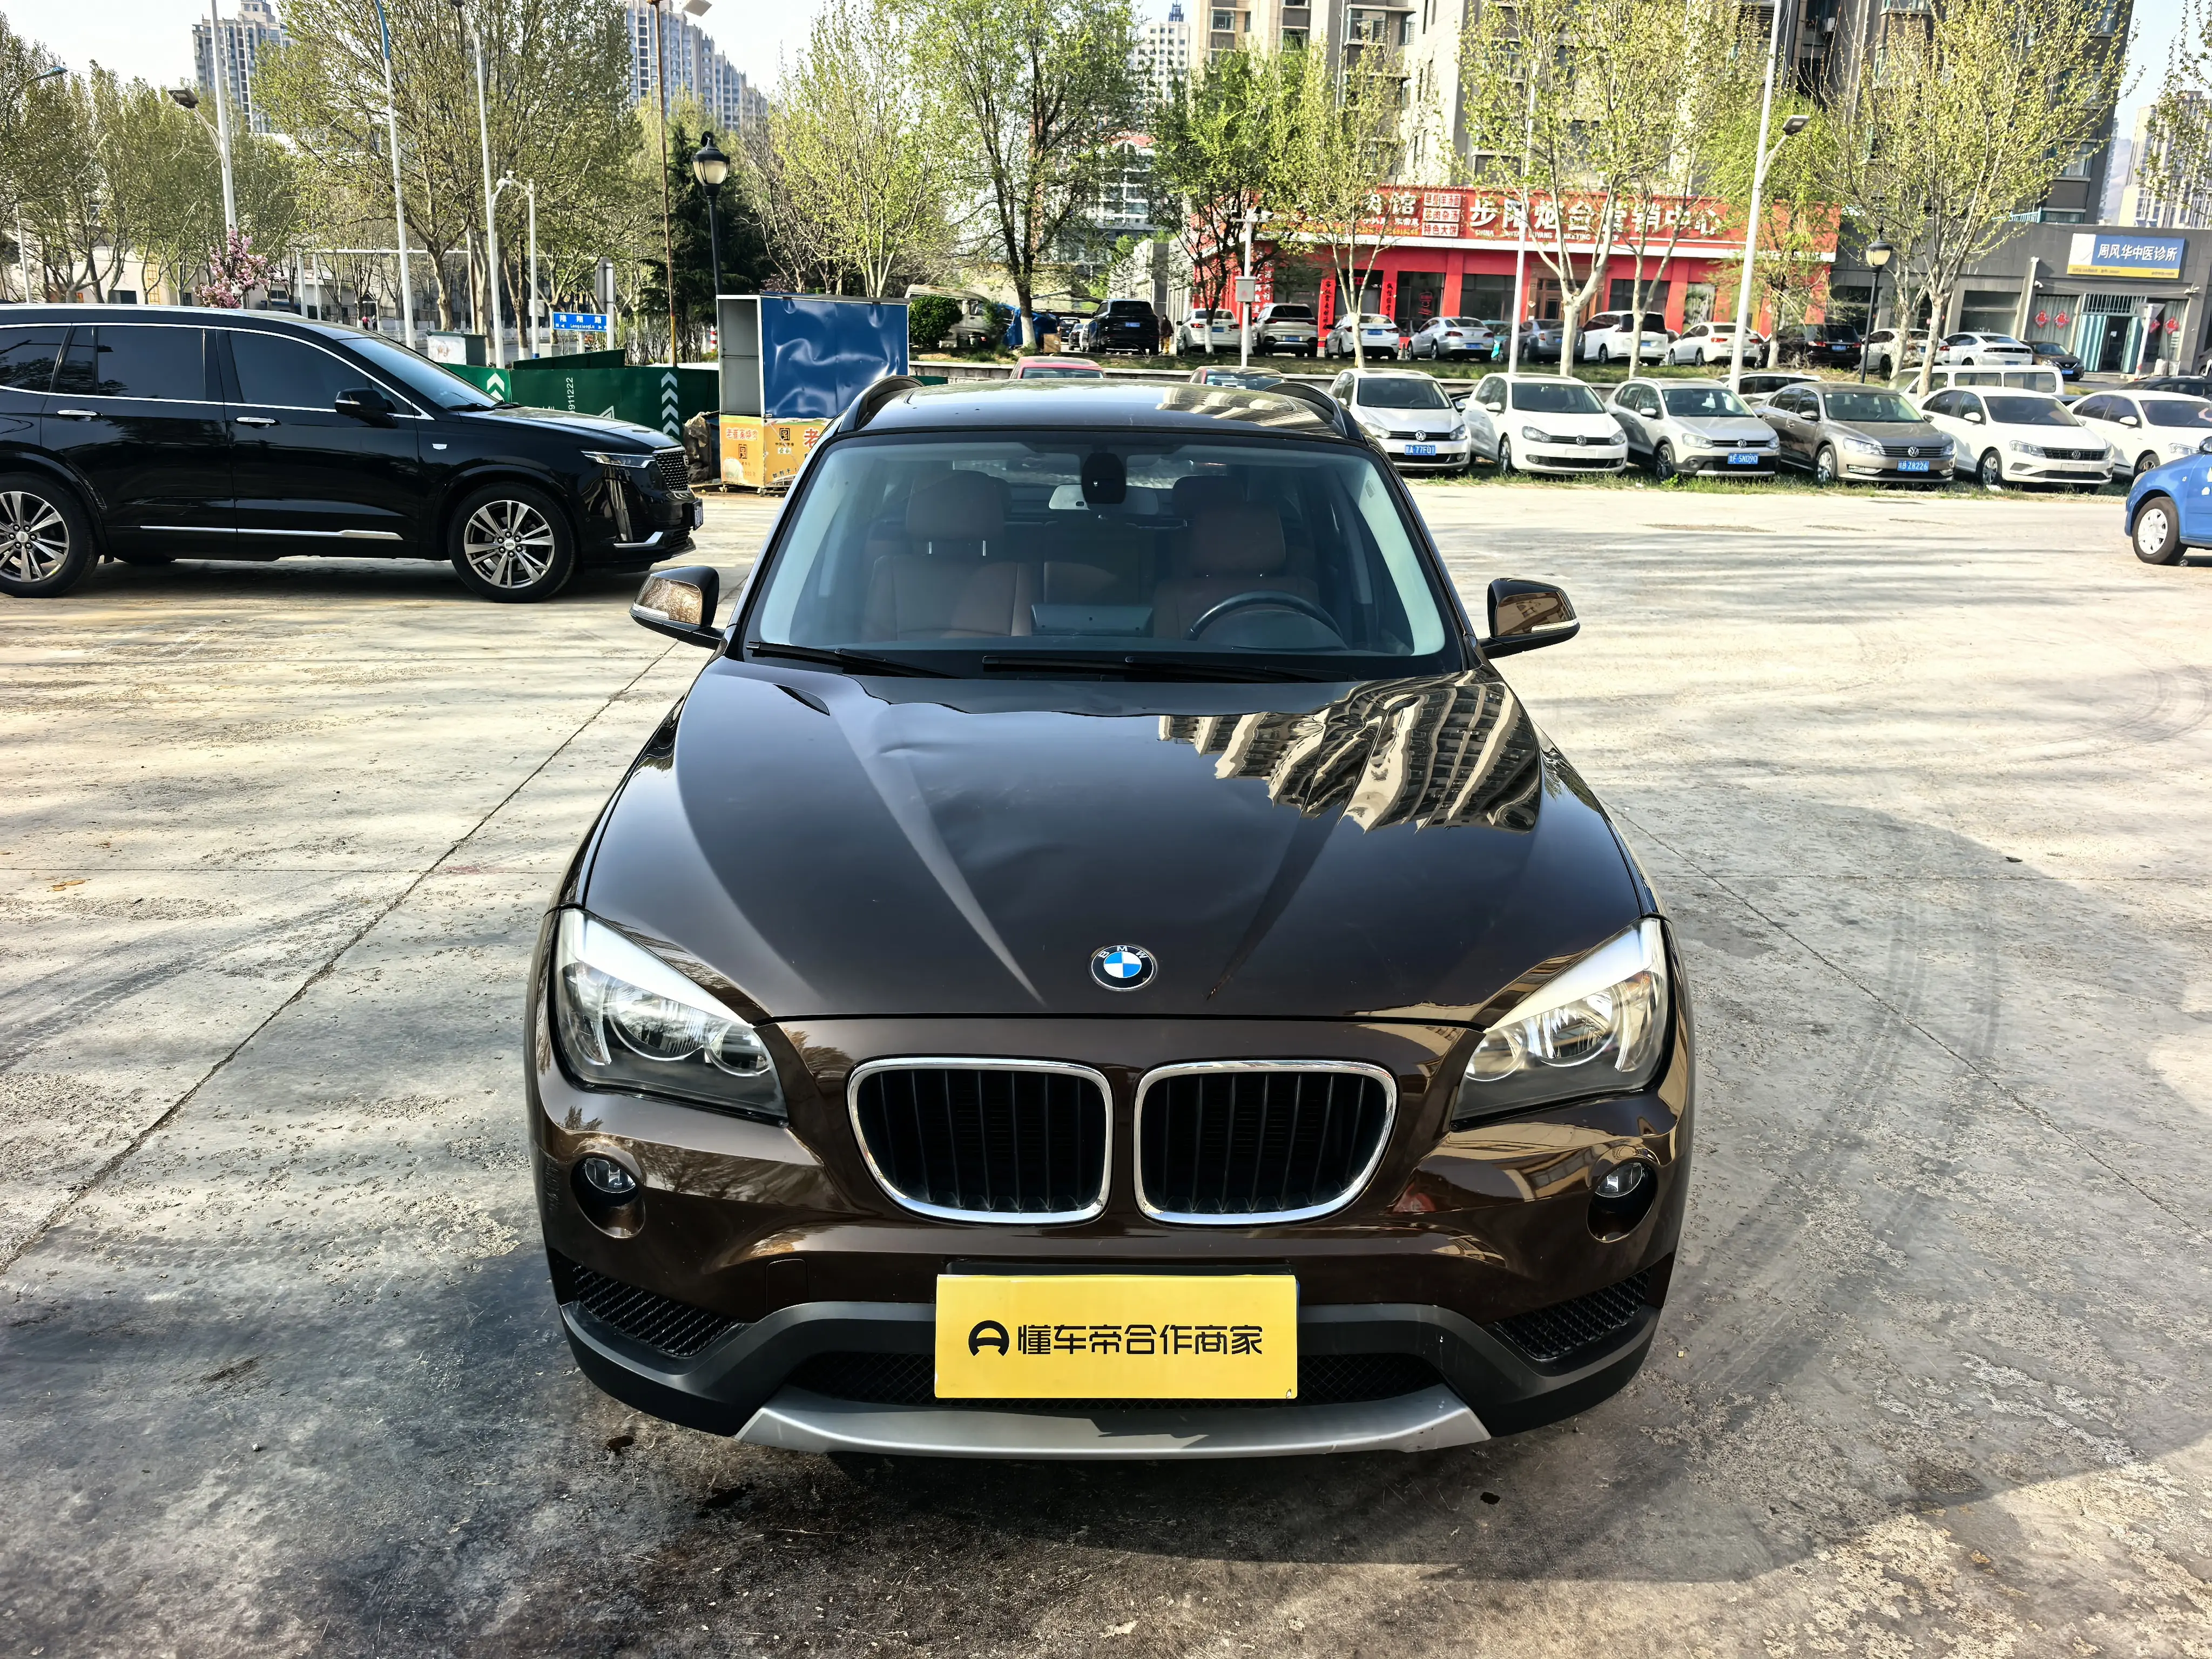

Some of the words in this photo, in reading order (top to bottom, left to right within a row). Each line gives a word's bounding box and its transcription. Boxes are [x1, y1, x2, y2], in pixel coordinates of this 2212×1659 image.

[1424, 224, 1457, 235] 特色大饼
[2098, 244, 2178, 261] 周风华中医诊所
[566, 377, 576, 413] 911222
[1097, 945, 1149, 959] BMW
[1017, 1324, 1263, 1354] 懂车帝合作商家
